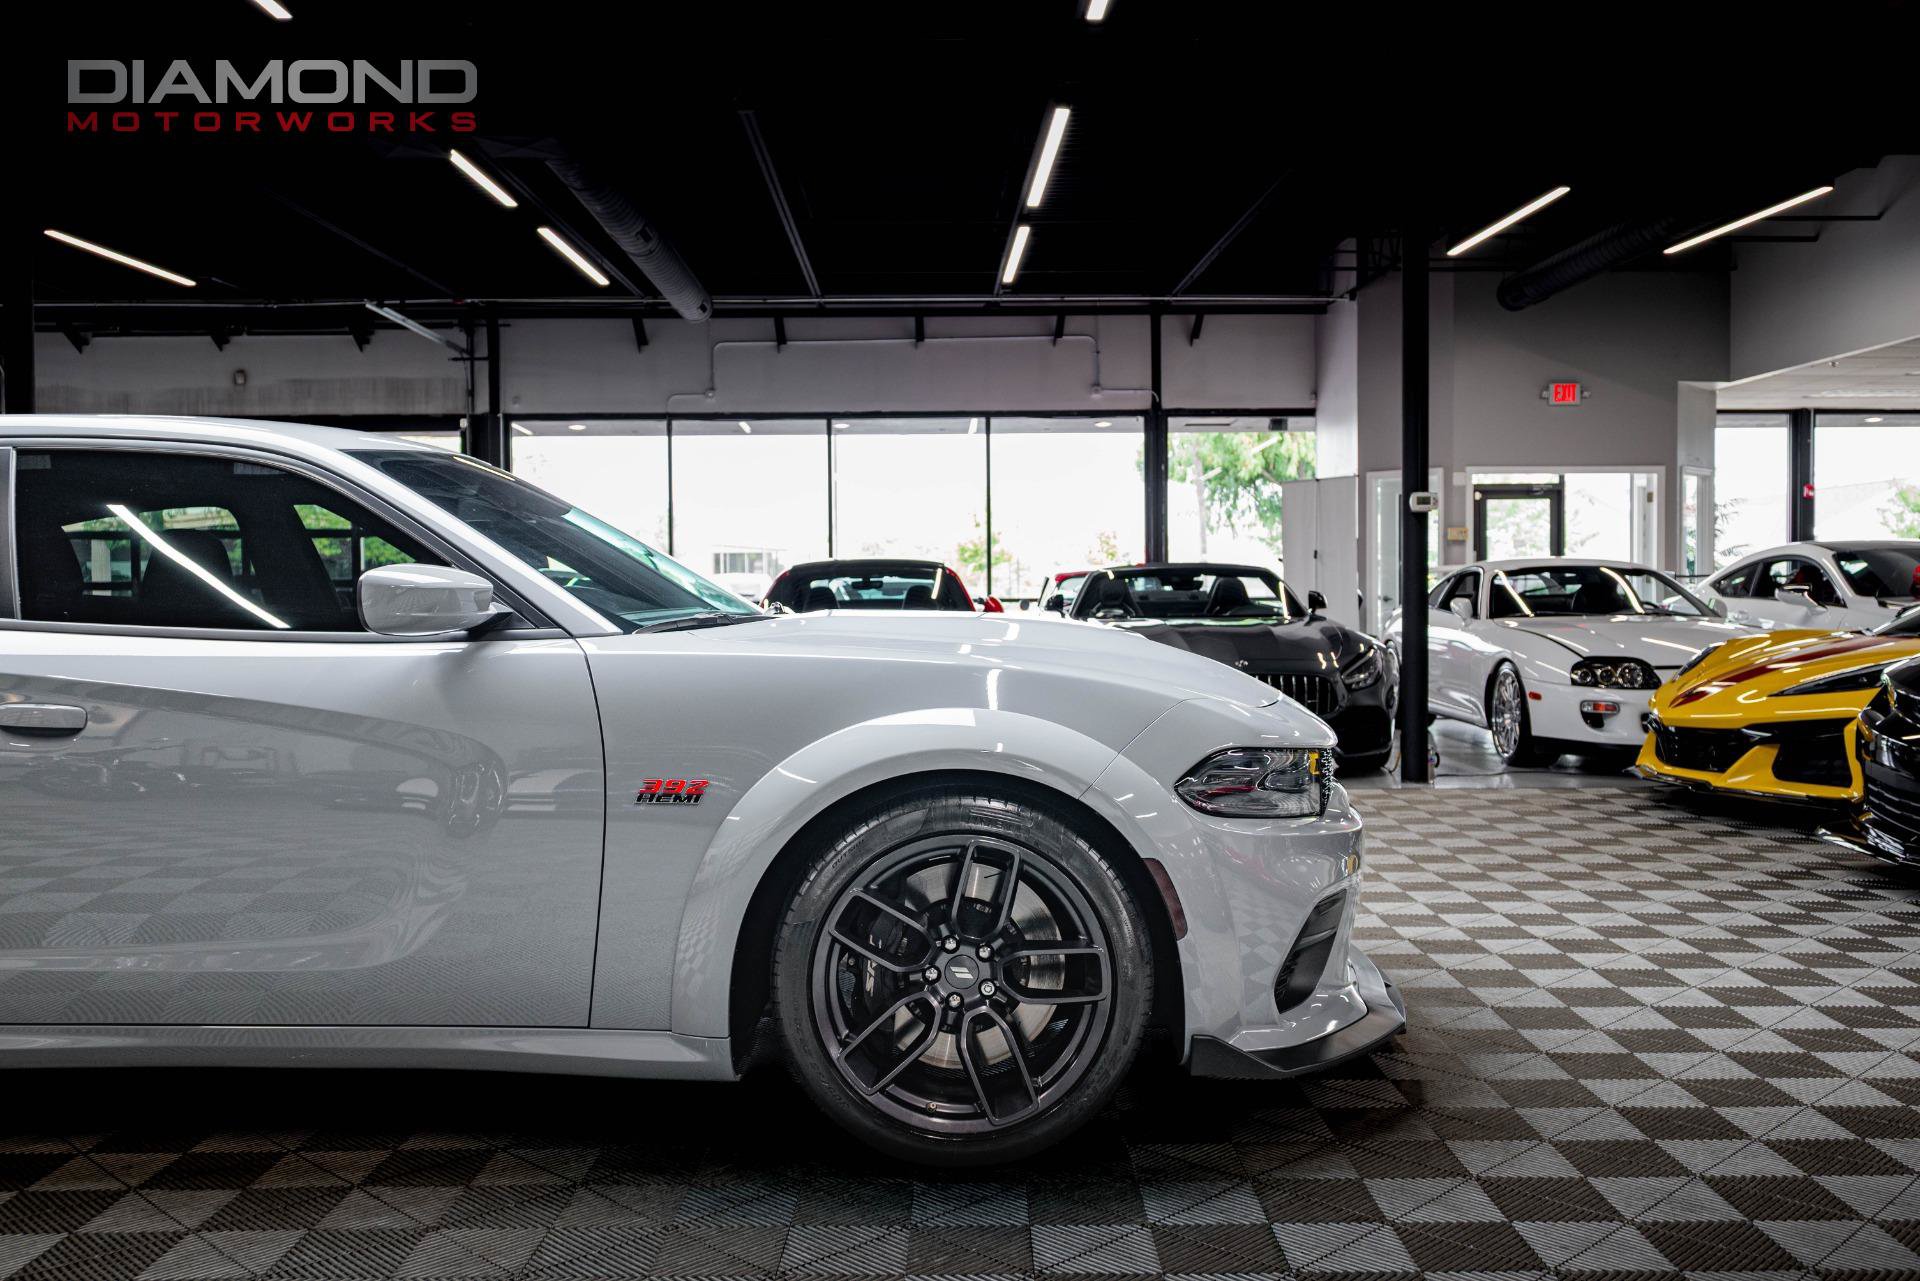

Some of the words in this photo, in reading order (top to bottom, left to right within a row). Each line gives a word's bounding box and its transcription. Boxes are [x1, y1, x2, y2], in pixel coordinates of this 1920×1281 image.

[1553, 383, 1577, 402] EXIT
[639, 778, 710, 795] 392
[634, 793, 703, 805] HEMI
[831, 838, 865, 869] OUTSI
